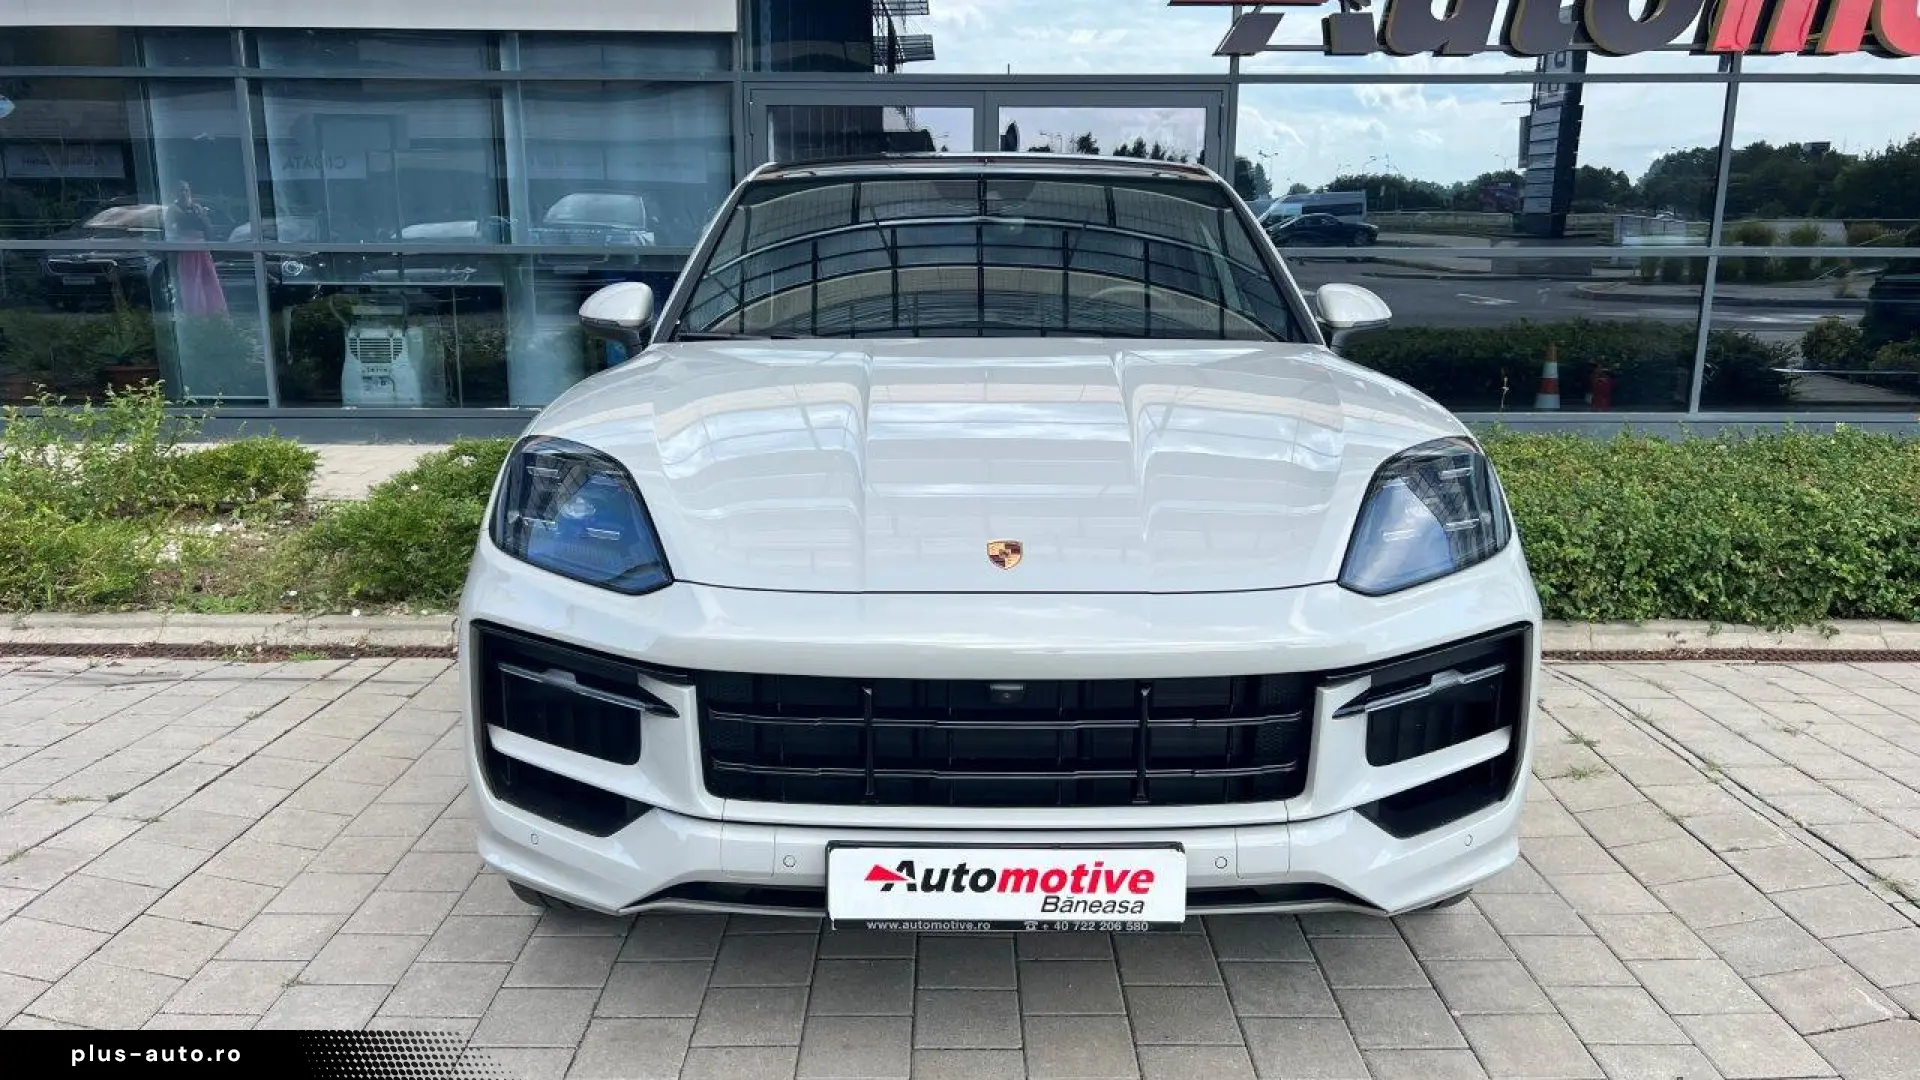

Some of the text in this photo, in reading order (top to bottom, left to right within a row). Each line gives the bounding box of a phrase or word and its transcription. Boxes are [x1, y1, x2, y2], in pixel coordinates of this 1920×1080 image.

[880, 860, 1155, 894] Automotive
[866, 920, 991, 931] www.automotive.ro
[1054, 921, 1069, 931] 40
[1074, 921, 1095, 931] 722
[1100, 921, 1121, 931] 206
[1126, 921, 1148, 931] 580
